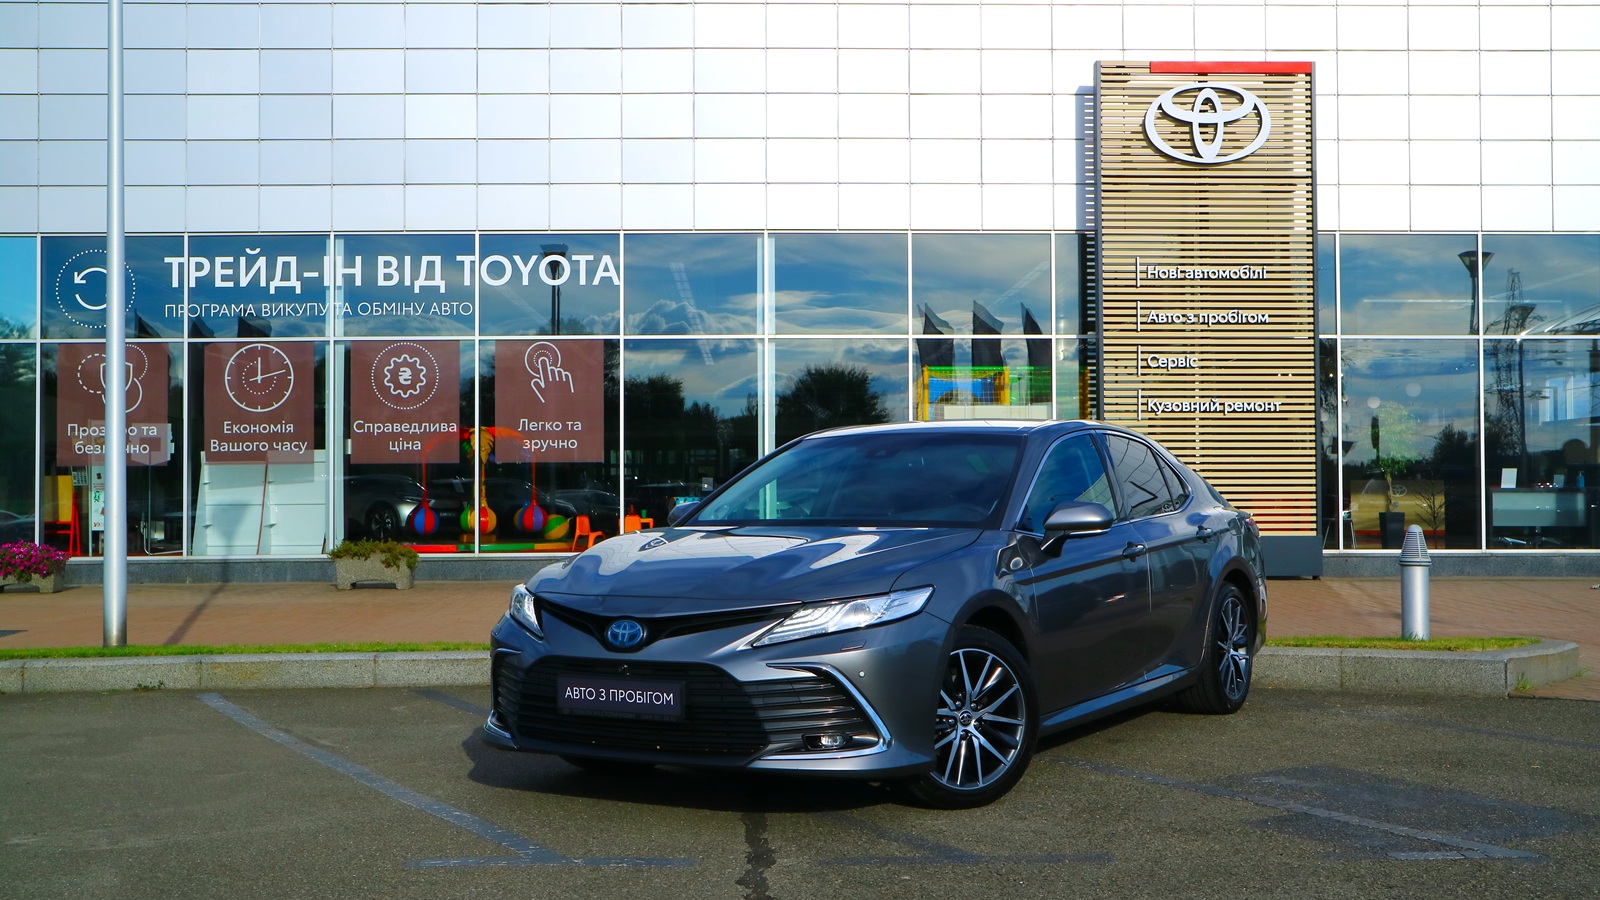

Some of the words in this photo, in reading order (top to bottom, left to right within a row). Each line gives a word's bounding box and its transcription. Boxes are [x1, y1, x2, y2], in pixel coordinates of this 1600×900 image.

[163, 247, 362, 294] ТРЕЙД-ІН
[377, 255, 446, 294] ВІД
[455, 254, 621, 286] TOYOTA
[1146, 265, 1181, 280] Нові
[1185, 265, 1267, 280] автомобілі
[164, 303, 256, 318] ПРОГРАМА
[261, 302, 329, 317] ВИКУПУ
[333, 302, 352, 316] ТА
[357, 301, 425, 317] ОБМІНУ
[429, 301, 473, 316] АВТО
[1146, 310, 1182, 324] Авто
[1186, 314, 1195, 324] з
[1199, 309, 1269, 327] пробігом
[1146, 354, 1199, 371] Сервіс
[1147, 398, 1220, 415] Кузовний
[1224, 401, 1282, 415] ремонт
[67, 423, 138, 440] Прозо
[141, 426, 158, 436] та
[223, 420, 294, 434] Економія
[353, 420, 457, 436] Справедлива
[517, 418, 562, 431] Легко
[566, 421, 582, 431] та
[74, 441, 150, 455] безно
[210, 439, 269, 452] Вашого
[273, 441, 308, 455] часу
[389, 438, 421, 453] ціна
[522, 439, 578, 453] зручно
[564, 686, 596, 701] АВТО
[609, 689, 674, 706] ПРОБІГОМ
